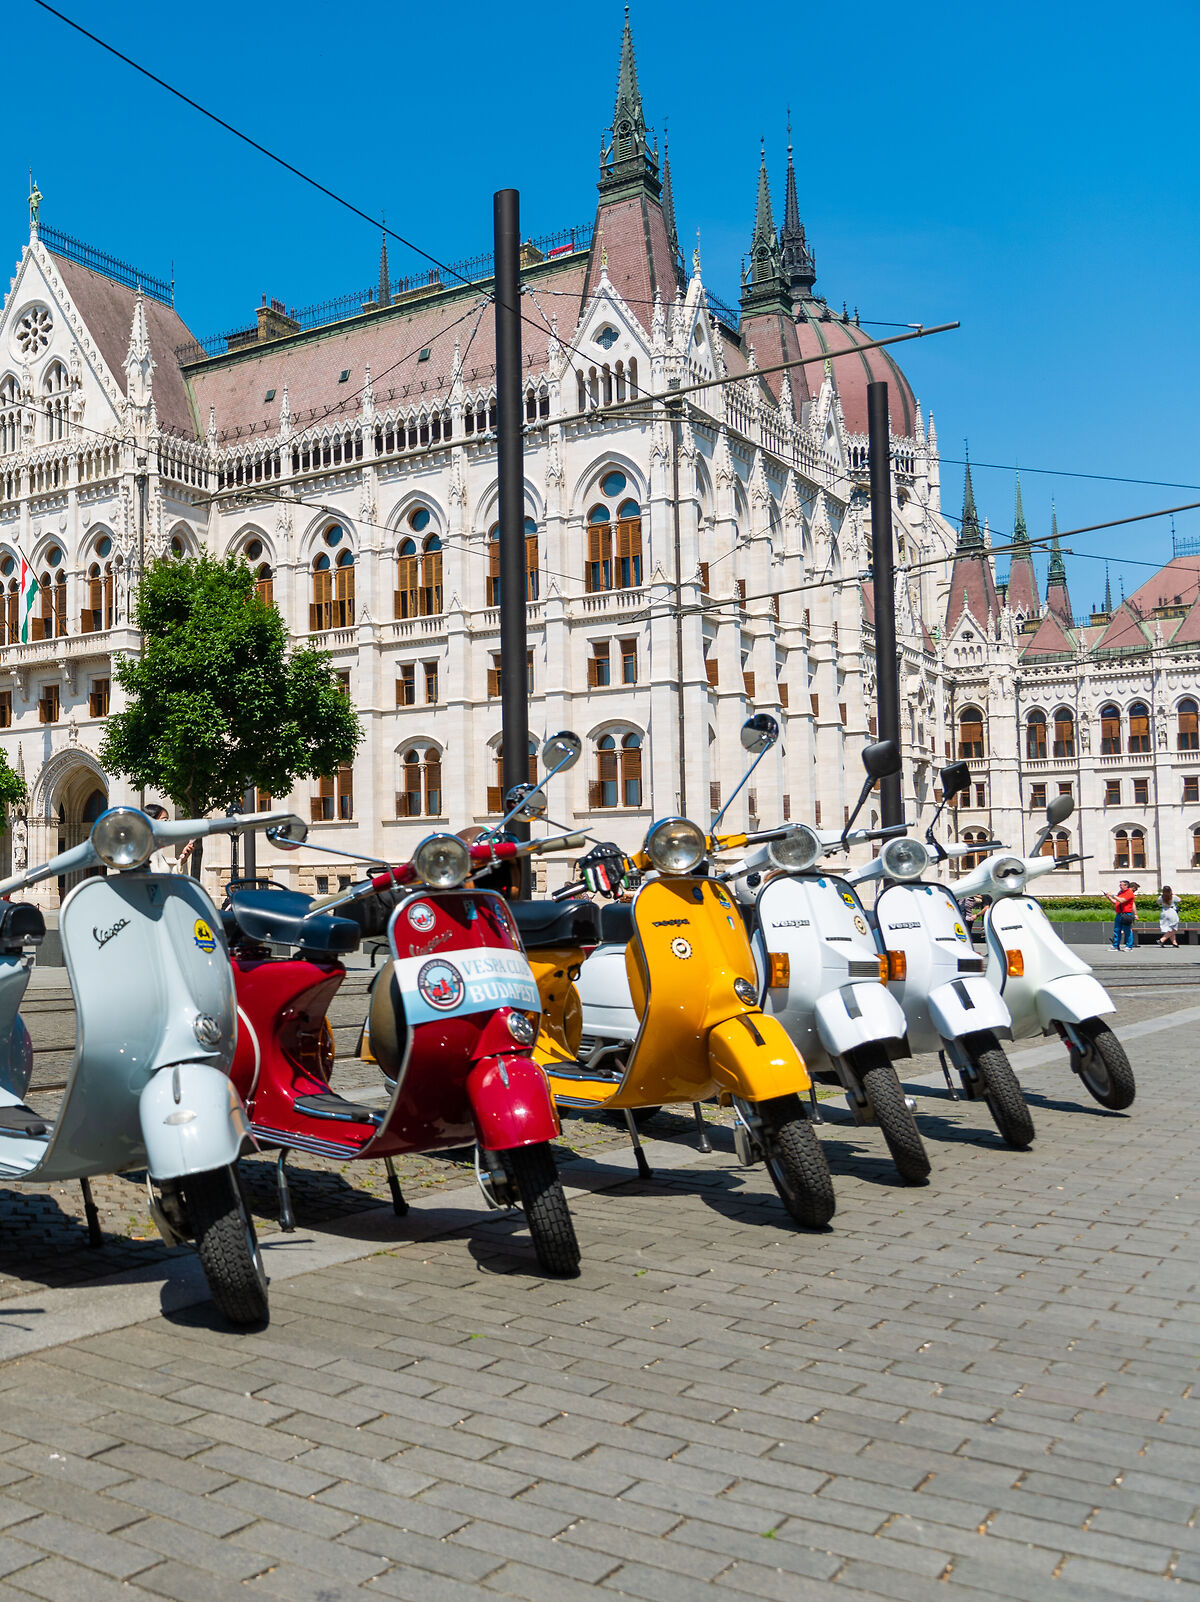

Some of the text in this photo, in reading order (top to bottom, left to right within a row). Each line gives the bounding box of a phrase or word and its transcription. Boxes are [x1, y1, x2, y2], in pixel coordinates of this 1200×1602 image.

[93, 918, 131, 949] Vespa
[461, 958, 506, 975] VESPA
[469, 981, 536, 1004] BUDAPEST
